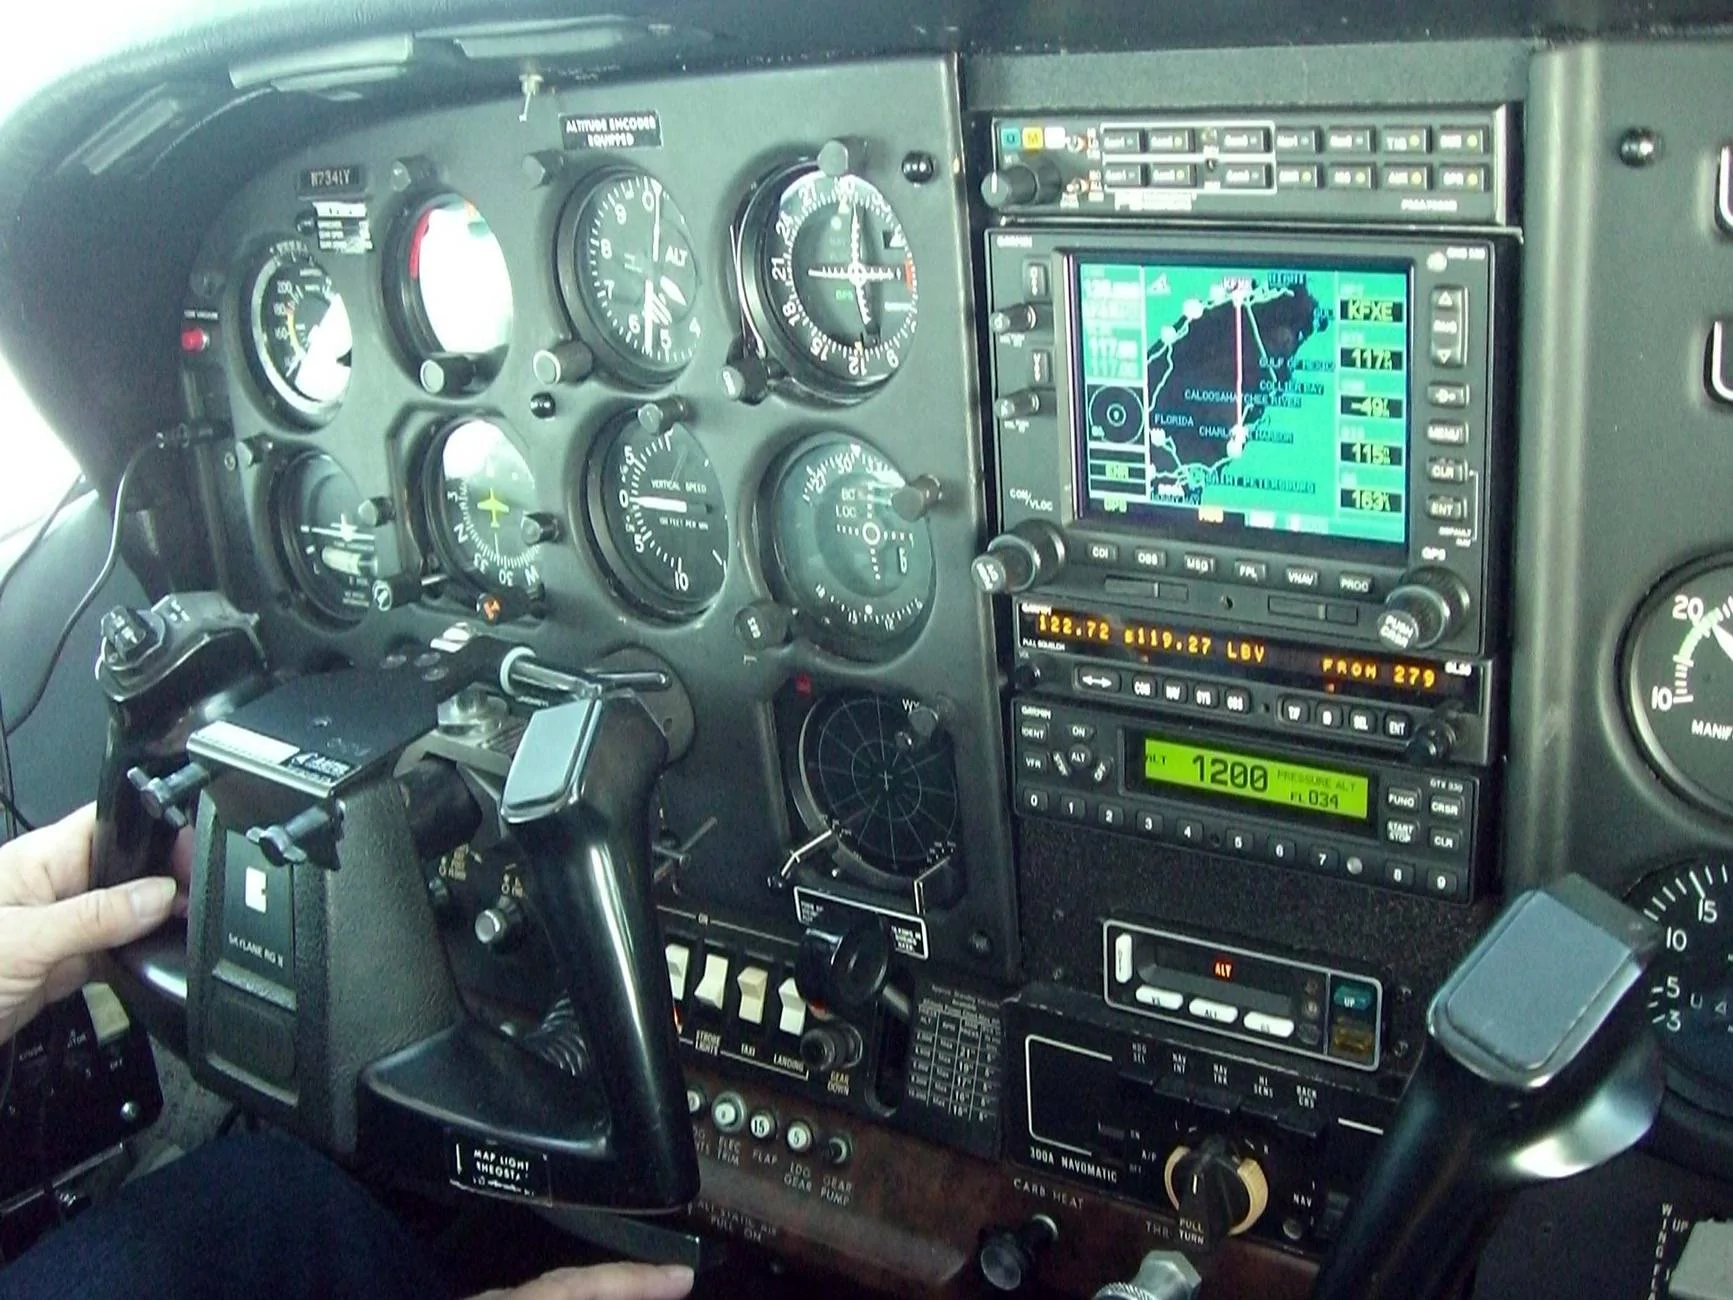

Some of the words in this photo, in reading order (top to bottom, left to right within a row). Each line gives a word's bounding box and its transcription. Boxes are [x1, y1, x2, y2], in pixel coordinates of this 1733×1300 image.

[665, 245, 688, 267] ALT
[1347, 299, 1394, 321] KFXE
[1154, 414, 1195, 427] FLORIDA
[650, 479, 681, 492] VERTICAL
[685, 482, 707, 494] SPEED
[453, 522, 469, 544] N
[674, 570, 689, 592] 10
[1672, 594, 1704, 622] 20
[1038, 614, 1110, 640] 122.72
[1322, 657, 1378, 680] FROM
[1393, 664, 1436, 688] 279
[1651, 685, 1674, 711] 10
[1071, 726, 1086, 738] ON
[1071, 751, 1087, 763] ALT
[1191, 754, 1268, 794] 1200
[1276, 768, 1332, 790] PRESSURE
[1335, 779, 1357, 793] ALT
[1029, 793, 1039, 808] 0
[1067, 801, 1075, 815] 1
[1308, 789, 1340, 811] 034
[1104, 808, 1114, 819] 2
[1143, 815, 1154, 831] 3
[1183, 825, 1193, 838] 4
[1317, 852, 1328, 867] 7
[1392, 867, 1403, 882] 8
[1436, 875, 1447, 890] 9
[1698, 899, 1718, 924] 15
[1665, 926, 1688, 951] 10
[1666, 975, 1681, 999] 5
[1343, 996, 1356, 1008] UP
[1666, 1009, 1682, 1032] 3
[773, 1052, 805, 1073] LANDING
[473, 1148, 496, 1163] MAP
[1061, 1155, 1118, 1184] NAVOMATIC
[783, 1173, 813, 1193] GEAR
[1013, 1178, 1047, 1198] CARB
[1052, 1190, 1085, 1210] HEAT
